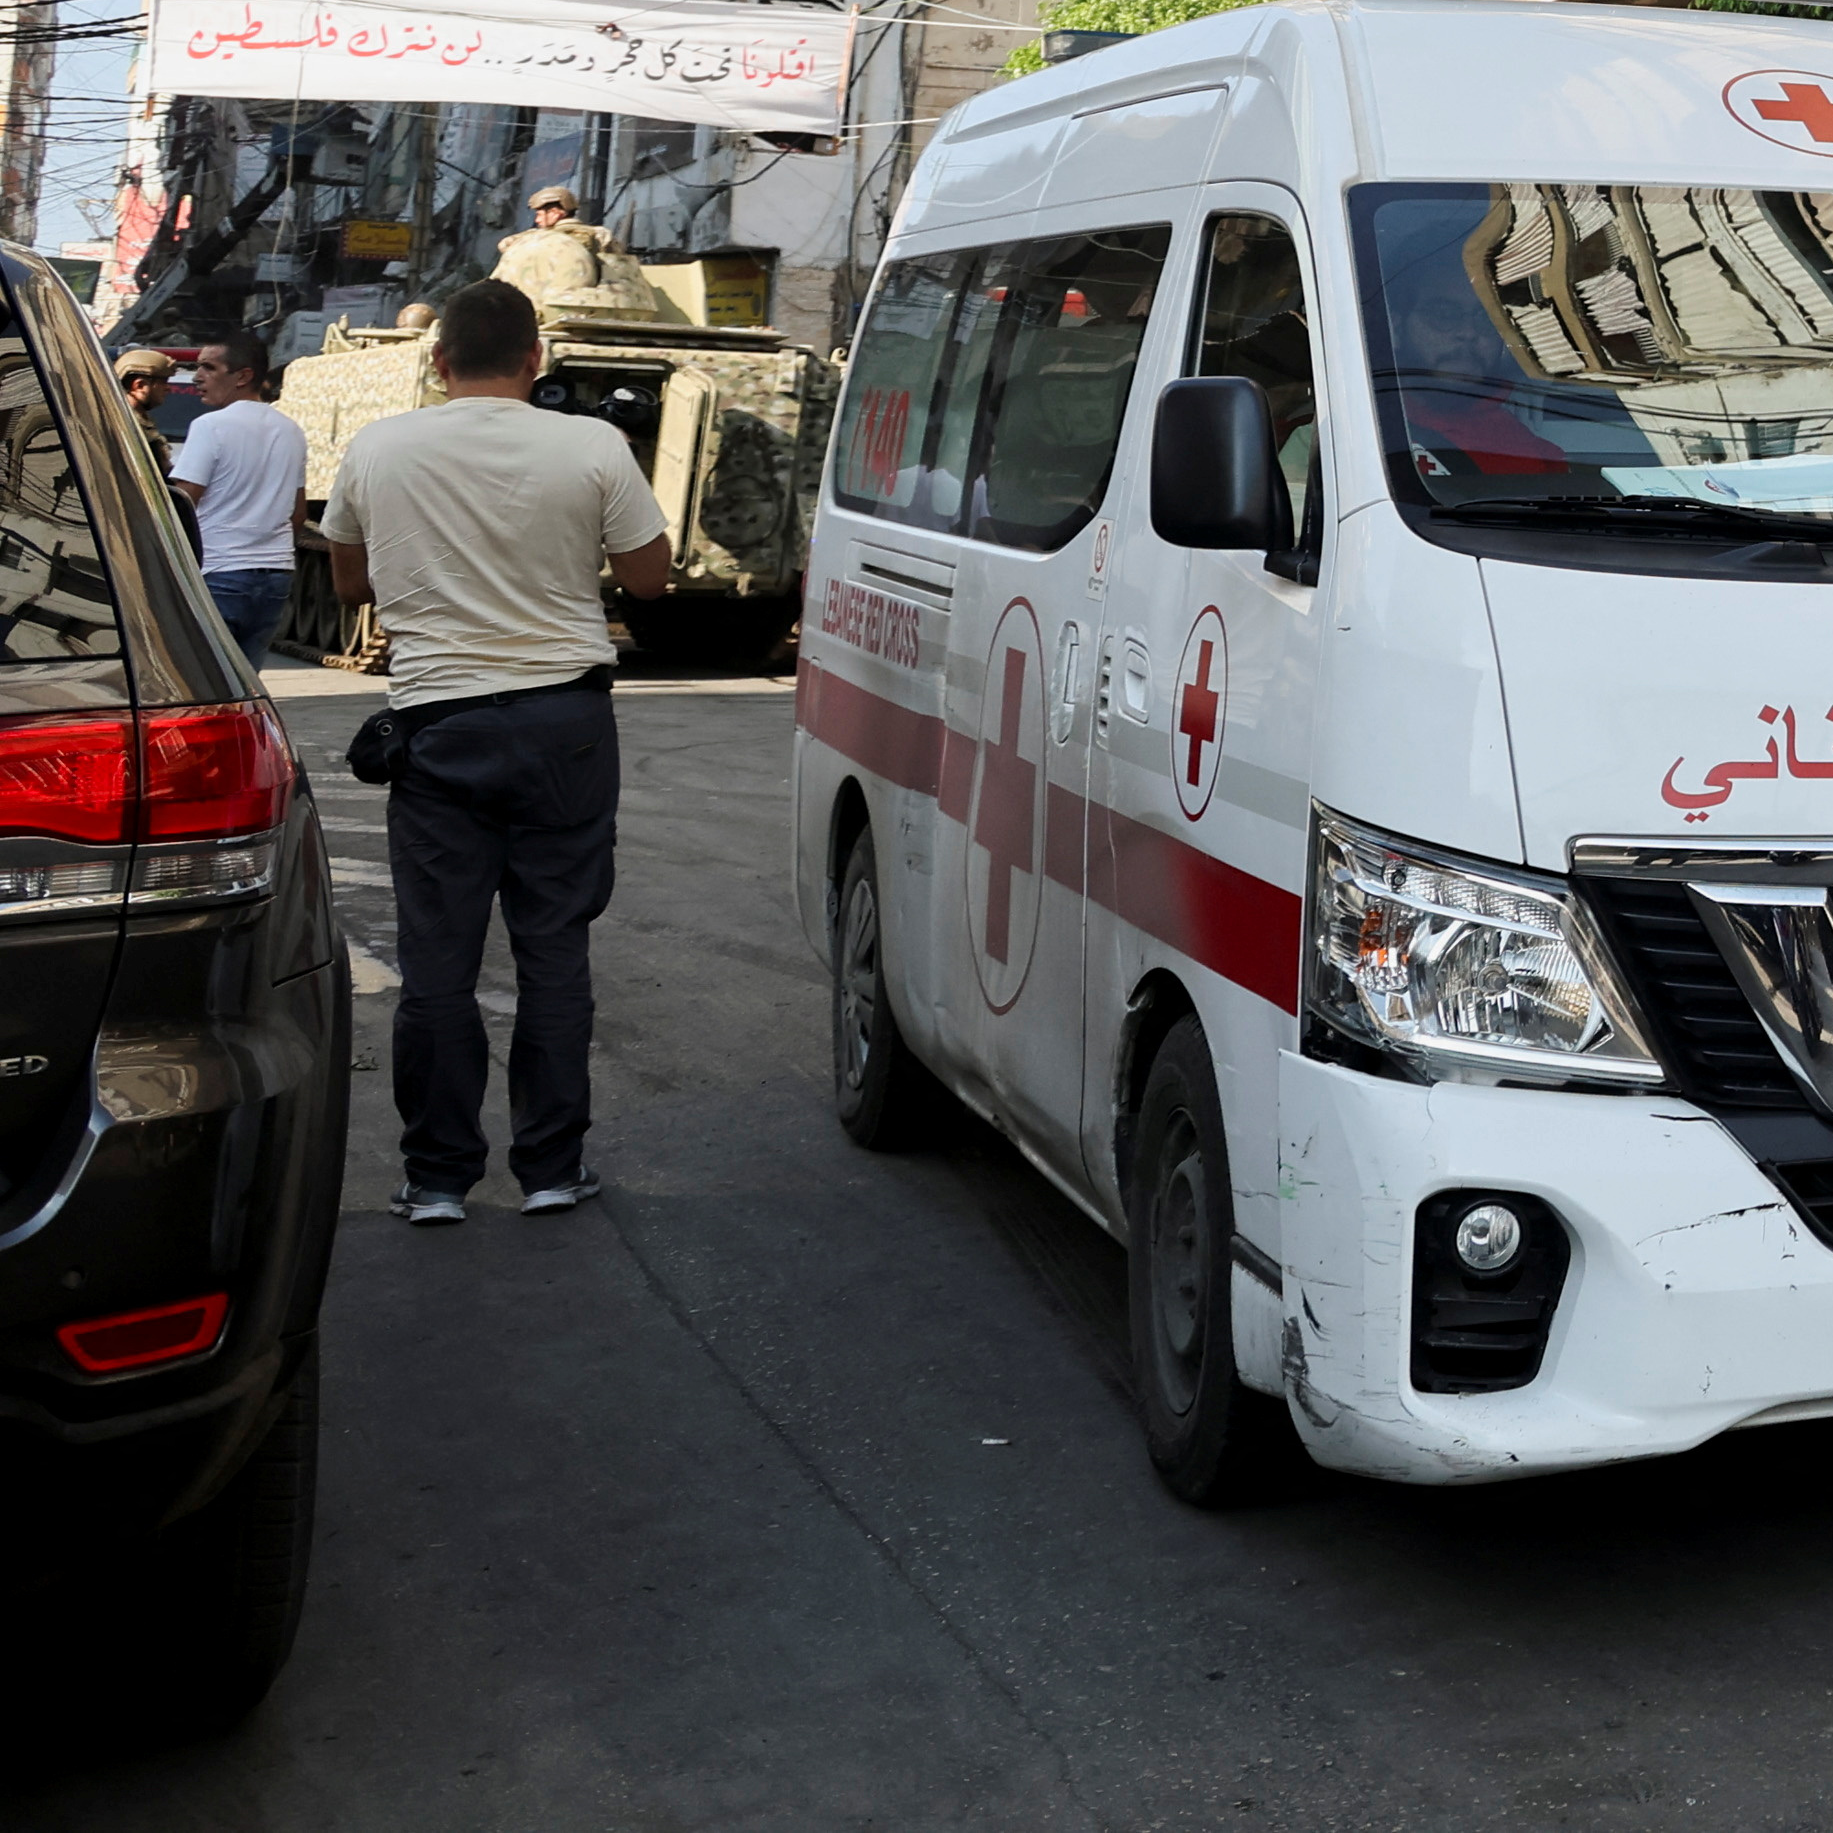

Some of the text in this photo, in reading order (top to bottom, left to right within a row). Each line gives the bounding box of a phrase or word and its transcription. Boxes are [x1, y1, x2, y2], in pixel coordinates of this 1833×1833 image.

[187, 2, 338, 61] فلسطين
[347, 24, 436, 59] نترك
[644, 39, 682, 81] كل
